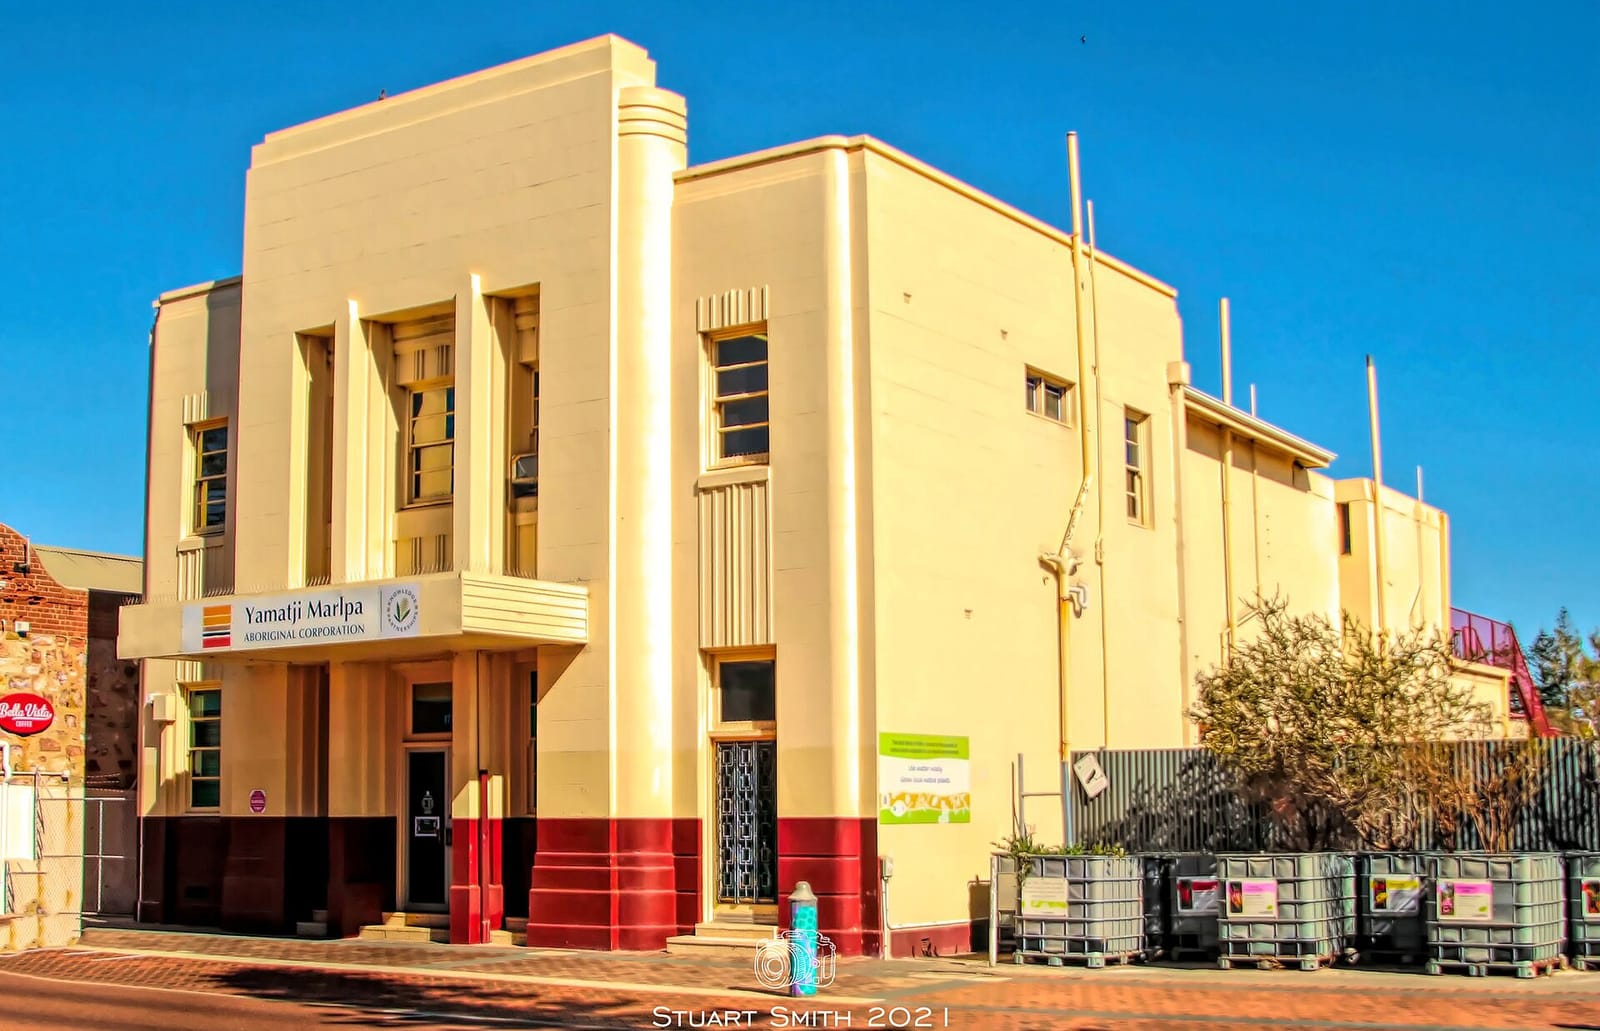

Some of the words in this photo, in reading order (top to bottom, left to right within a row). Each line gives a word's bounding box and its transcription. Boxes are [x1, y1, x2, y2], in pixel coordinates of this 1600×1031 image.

[245, 601, 302, 624] Yamatji
[307, 596, 363, 621] Marlpa
[244, 631, 296, 642] ABORIGINAL
[299, 624, 365, 638] CORPORATION
[25, 703, 52, 717] Vista
